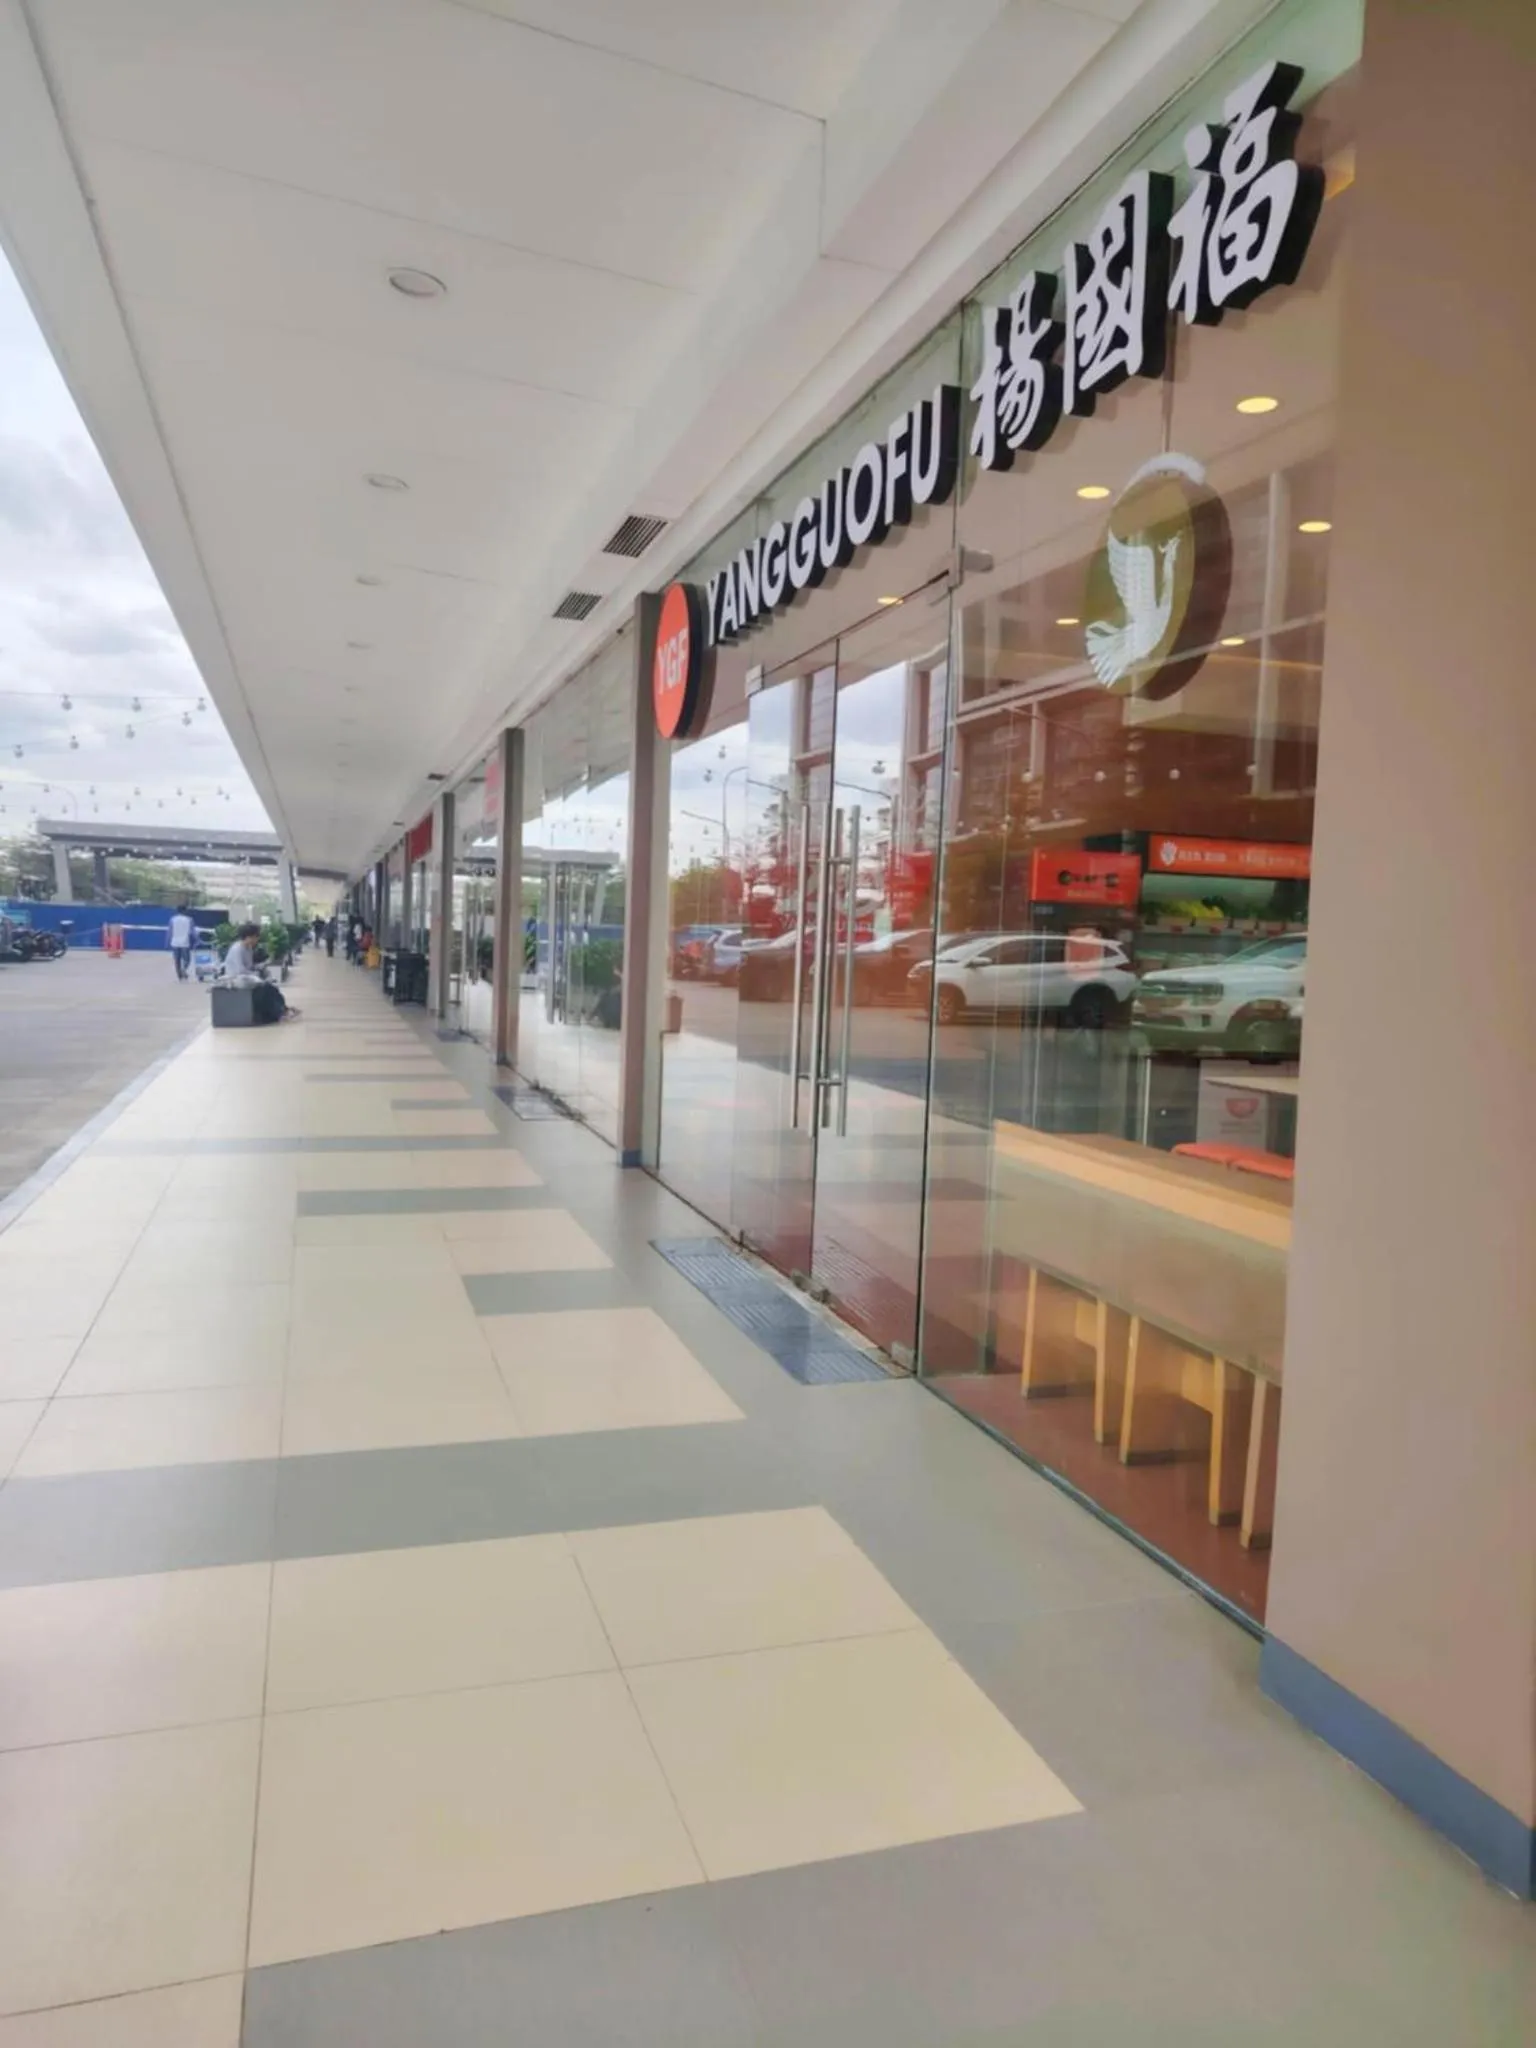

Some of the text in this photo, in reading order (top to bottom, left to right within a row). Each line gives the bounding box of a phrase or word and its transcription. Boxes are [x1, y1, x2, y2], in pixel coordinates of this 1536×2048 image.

[969, 61, 1299, 472] 楊國福
[705, 384, 944, 647] YANGGUOFU
[657, 628, 689, 695] YGF
